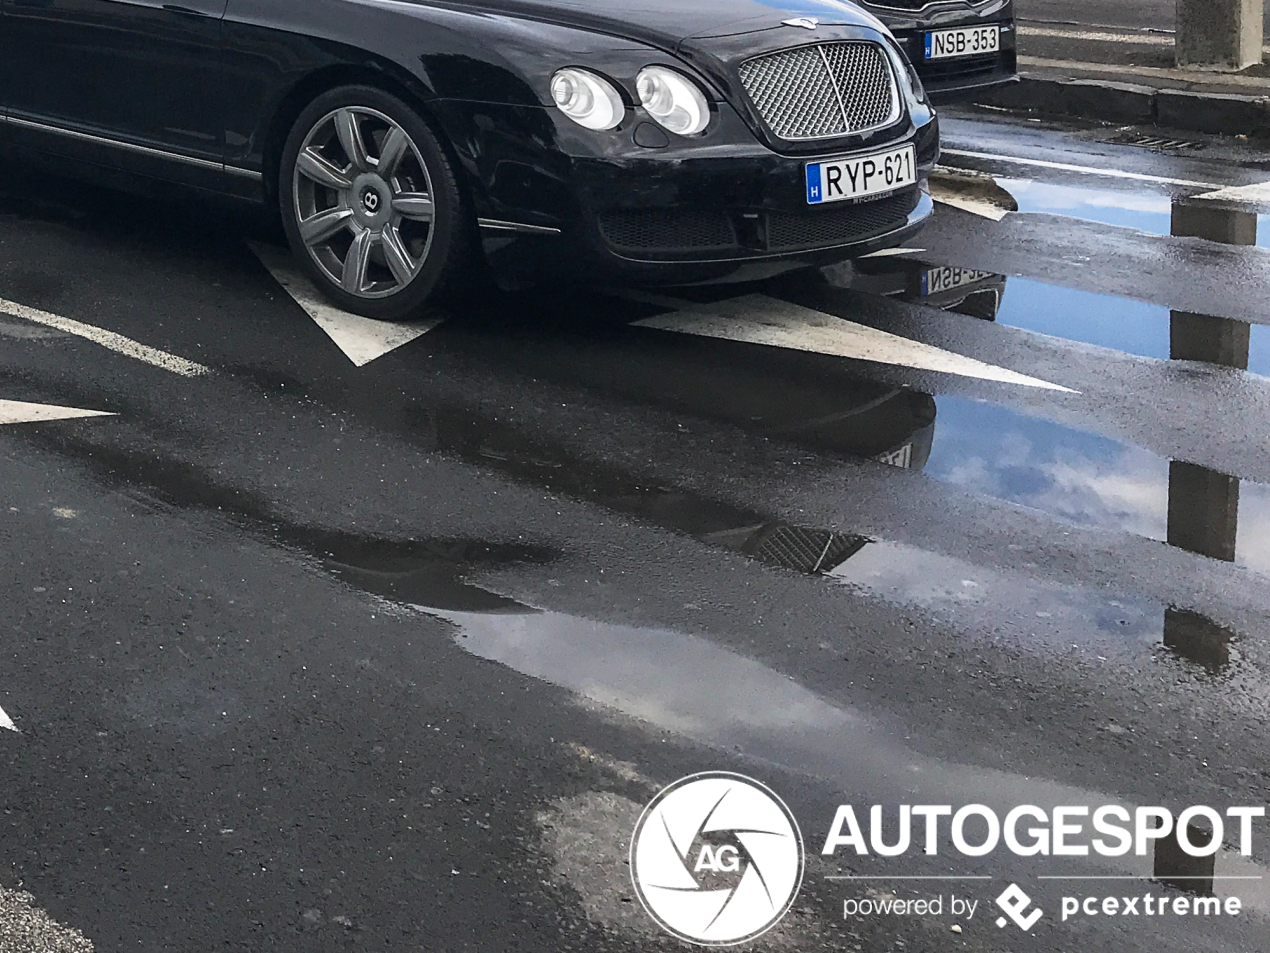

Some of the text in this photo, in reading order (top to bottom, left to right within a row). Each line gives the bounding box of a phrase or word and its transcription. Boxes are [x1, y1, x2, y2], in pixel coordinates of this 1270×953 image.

[934, 28, 997, 55] NSB-353
[811, 151, 911, 197] H RYP-621
